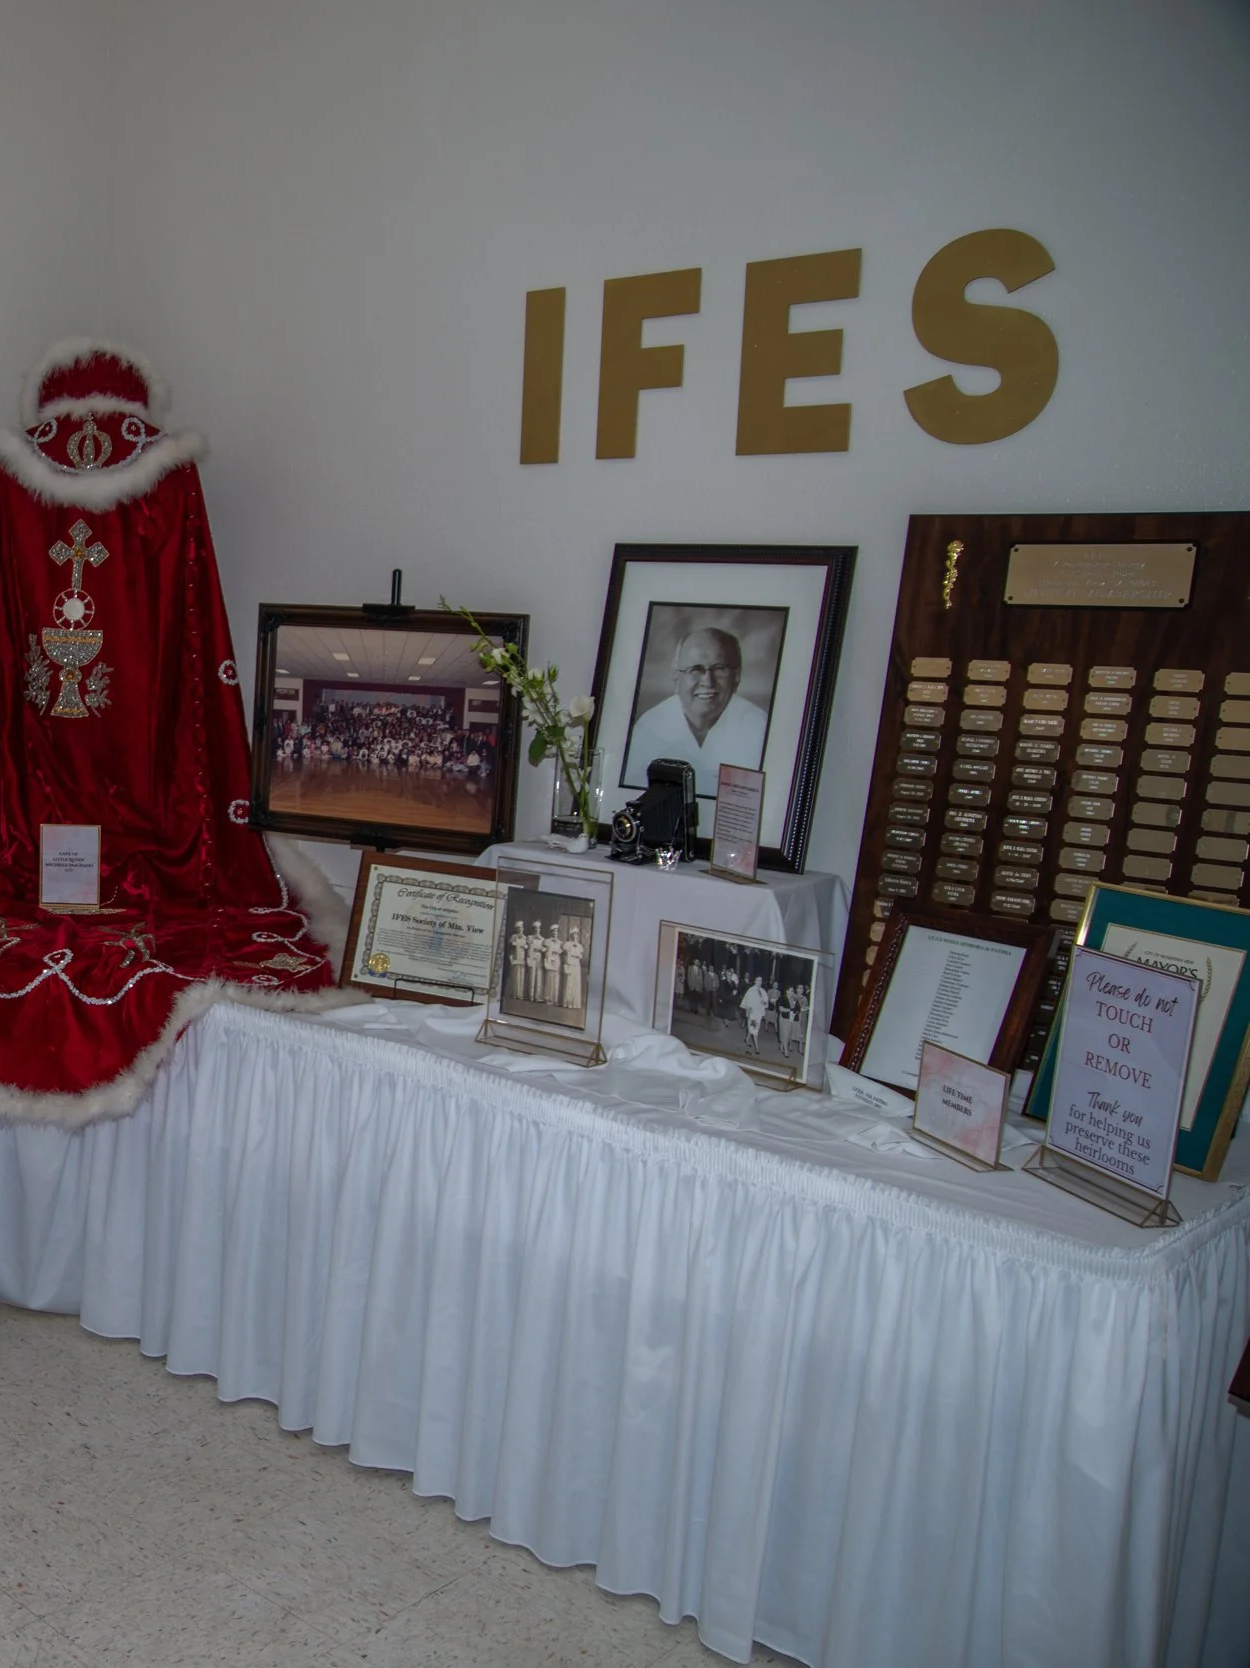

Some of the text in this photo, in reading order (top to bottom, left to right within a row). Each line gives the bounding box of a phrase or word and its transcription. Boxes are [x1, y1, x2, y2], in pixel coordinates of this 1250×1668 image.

[519, 228, 1059, 464] IFES
[397, 887, 494, 911] Certificate of Recognition
[391, 912, 411, 922] IFES
[412, 916, 437, 928] Society
[438, 920, 447, 929] of
[466, 924, 485, 934] View
[1086, 971, 1179, 1017] Please do not
[1095, 1000, 1153, 1033] TOUCH
[1108, 1033, 1131, 1054] OR
[1084, 1051, 1152, 1089] REMOVE
[942, 1098, 972, 1117] MEMBERS
[943, 1084, 972, 1105] LIFE TIME
[1087, 1091, 1143, 1127] Thank you
[1065, 1121, 1151, 1165] preserve these
[1069, 1104, 1151, 1149] for helping us
[1074, 1137, 1135, 1175] heirlooms
